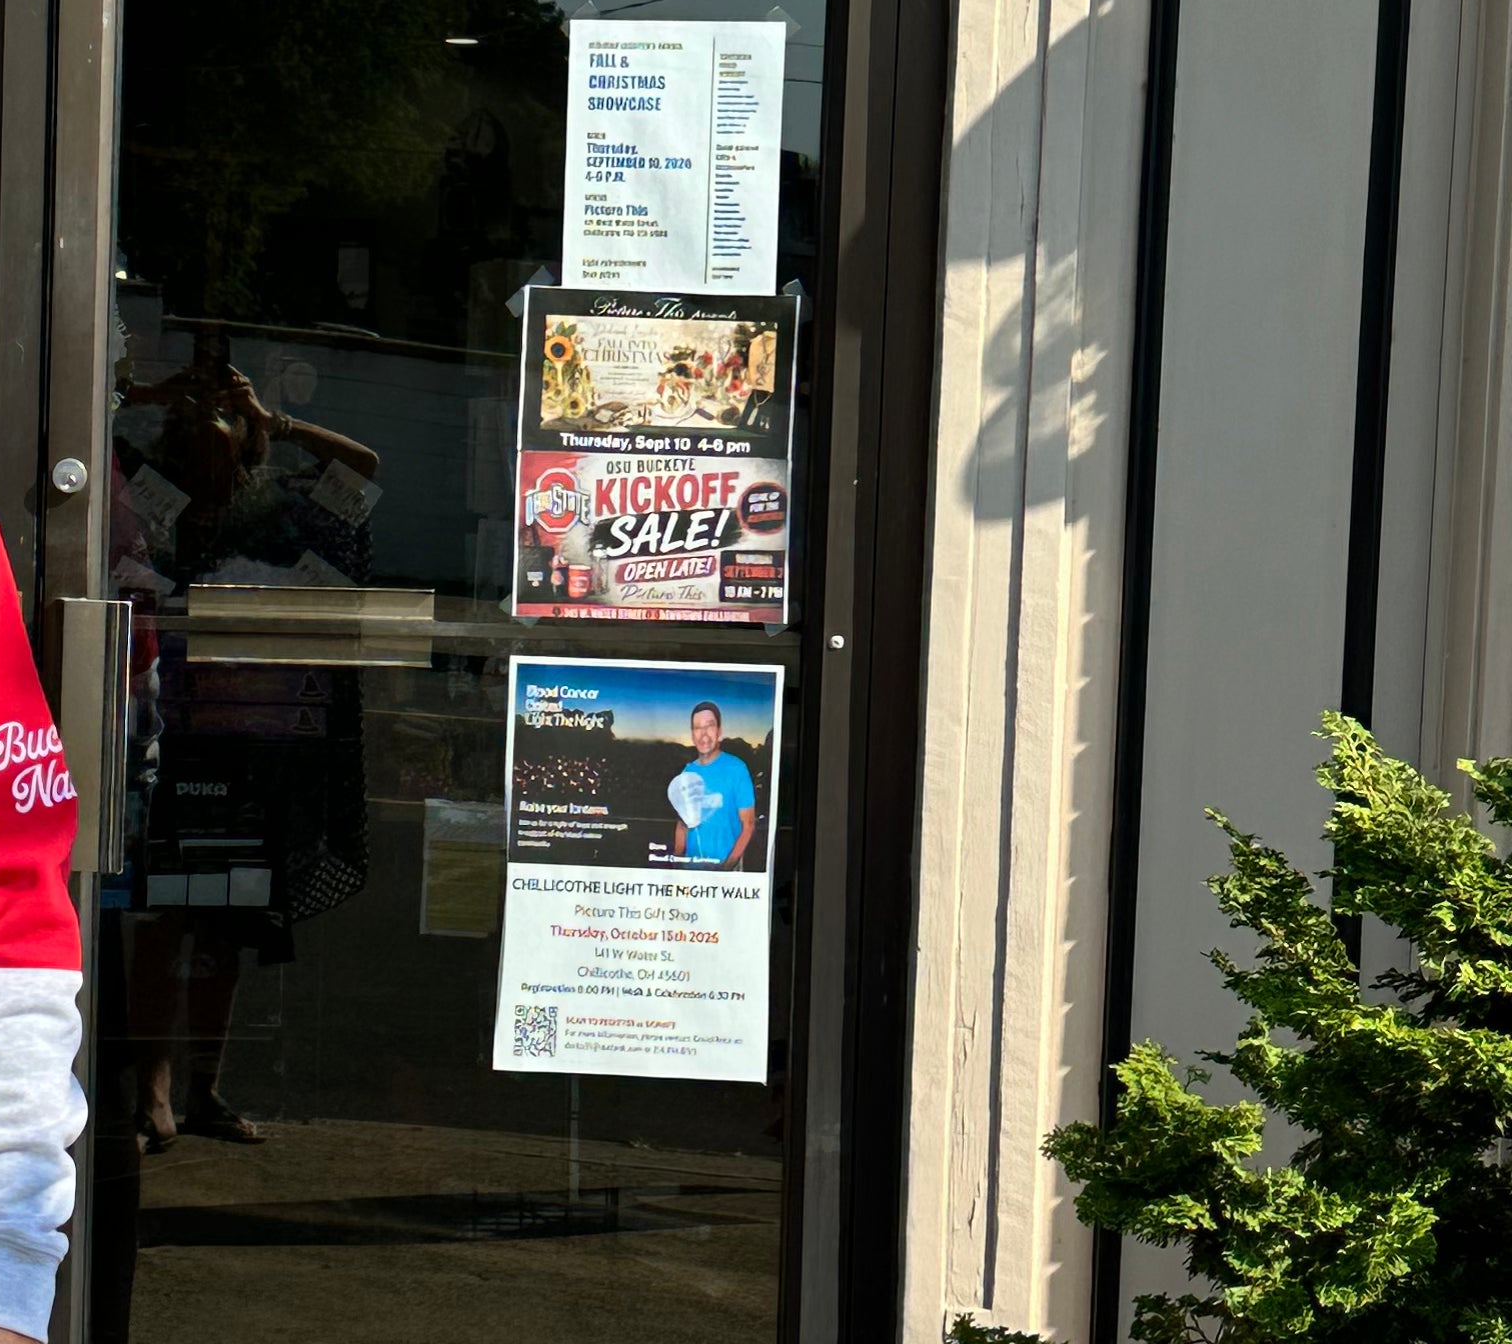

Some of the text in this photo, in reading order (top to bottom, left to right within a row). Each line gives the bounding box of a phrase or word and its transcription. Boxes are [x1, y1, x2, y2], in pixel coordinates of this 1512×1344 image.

[589, 54, 629, 68] FALL &
[589, 75, 666, 89] CHRISTMAS
[588, 97, 661, 111] SHOWCASE
[560, 432, 631, 451] Thursday,
[635, 435, 670, 453] Sept
[674, 437, 690, 451] 10
[727, 441, 750, 455] pm
[607, 459, 696, 474] OSU BUCKEYE
[595, 472, 740, 517] KICKOFF
[607, 510, 731, 559] SALE!
[624, 556, 711, 582] OPEN LATE!
[555, 713, 574, 727] The
[512, 879, 761, 900] CHILLICOTHE LIGHT THE NIGHT WALK
[574, 905, 615, 918] Picture
[618, 906, 641, 918] This
[669, 909, 698, 923] Shop
